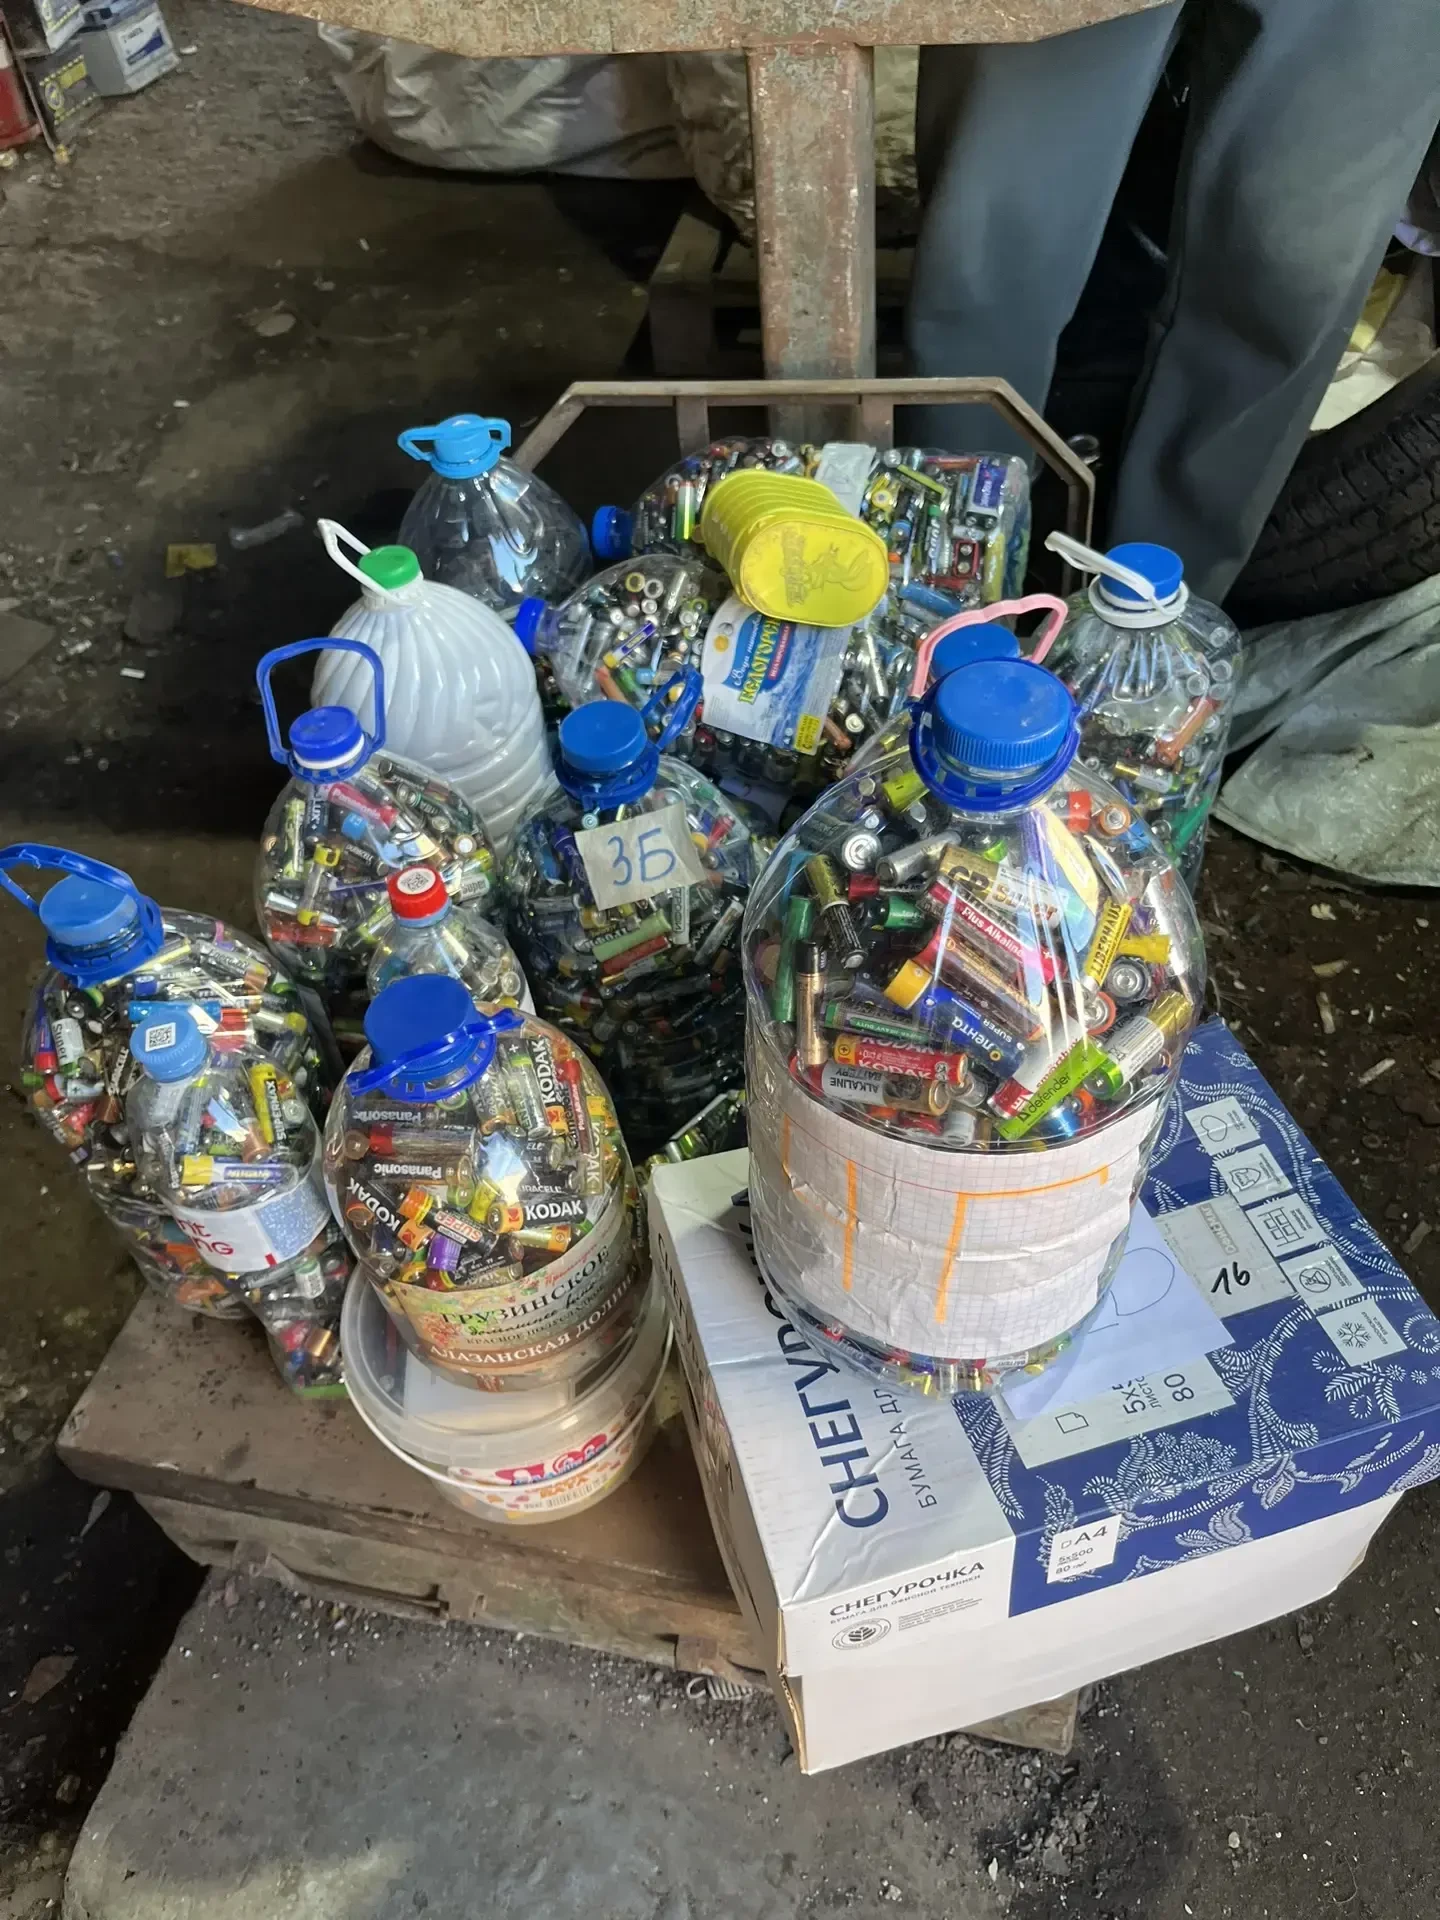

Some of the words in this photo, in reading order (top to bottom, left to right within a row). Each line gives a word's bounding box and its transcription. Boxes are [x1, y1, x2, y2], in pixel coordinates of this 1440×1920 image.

[962, 907, 985, 929] Plus
[982, 1019, 1013, 1043] SUPER
[531, 1038, 556, 1105] KODAK
[829, 1076, 880, 1094] ALKALINE
[1028, 1071, 1072, 1112] defender
[373, 1163, 442, 1179] Panasonic
[347, 1177, 401, 1231] KODAK
[519, 1185, 563, 1194] URACELL
[525, 1199, 584, 1221] KODAK
[441, 1246, 609, 1325] ГРУЗИНСКОЕ
[1210, 1261, 1251, 1296] 16
[430, 1333, 572, 1364] АЛАЗАНСКАЯ
[873, 1388, 901, 1414] ДЛ
[1163, 1373, 1195, 1402] 80
[886, 1421, 937, 1509] БУМАГА
[1074, 1525, 1108, 1545] A4
[1055, 1564, 1071, 1575] 80
[829, 1561, 985, 1617] СНЕГУРОЧКА
[830, 1609, 867, 1625] БУМАГА
[869, 1603, 888, 1613] ДЛЯ
[891, 1588, 937, 1606] ОФИСНОЙ
[940, 1574, 982, 1593] ТЕХНИКИ
